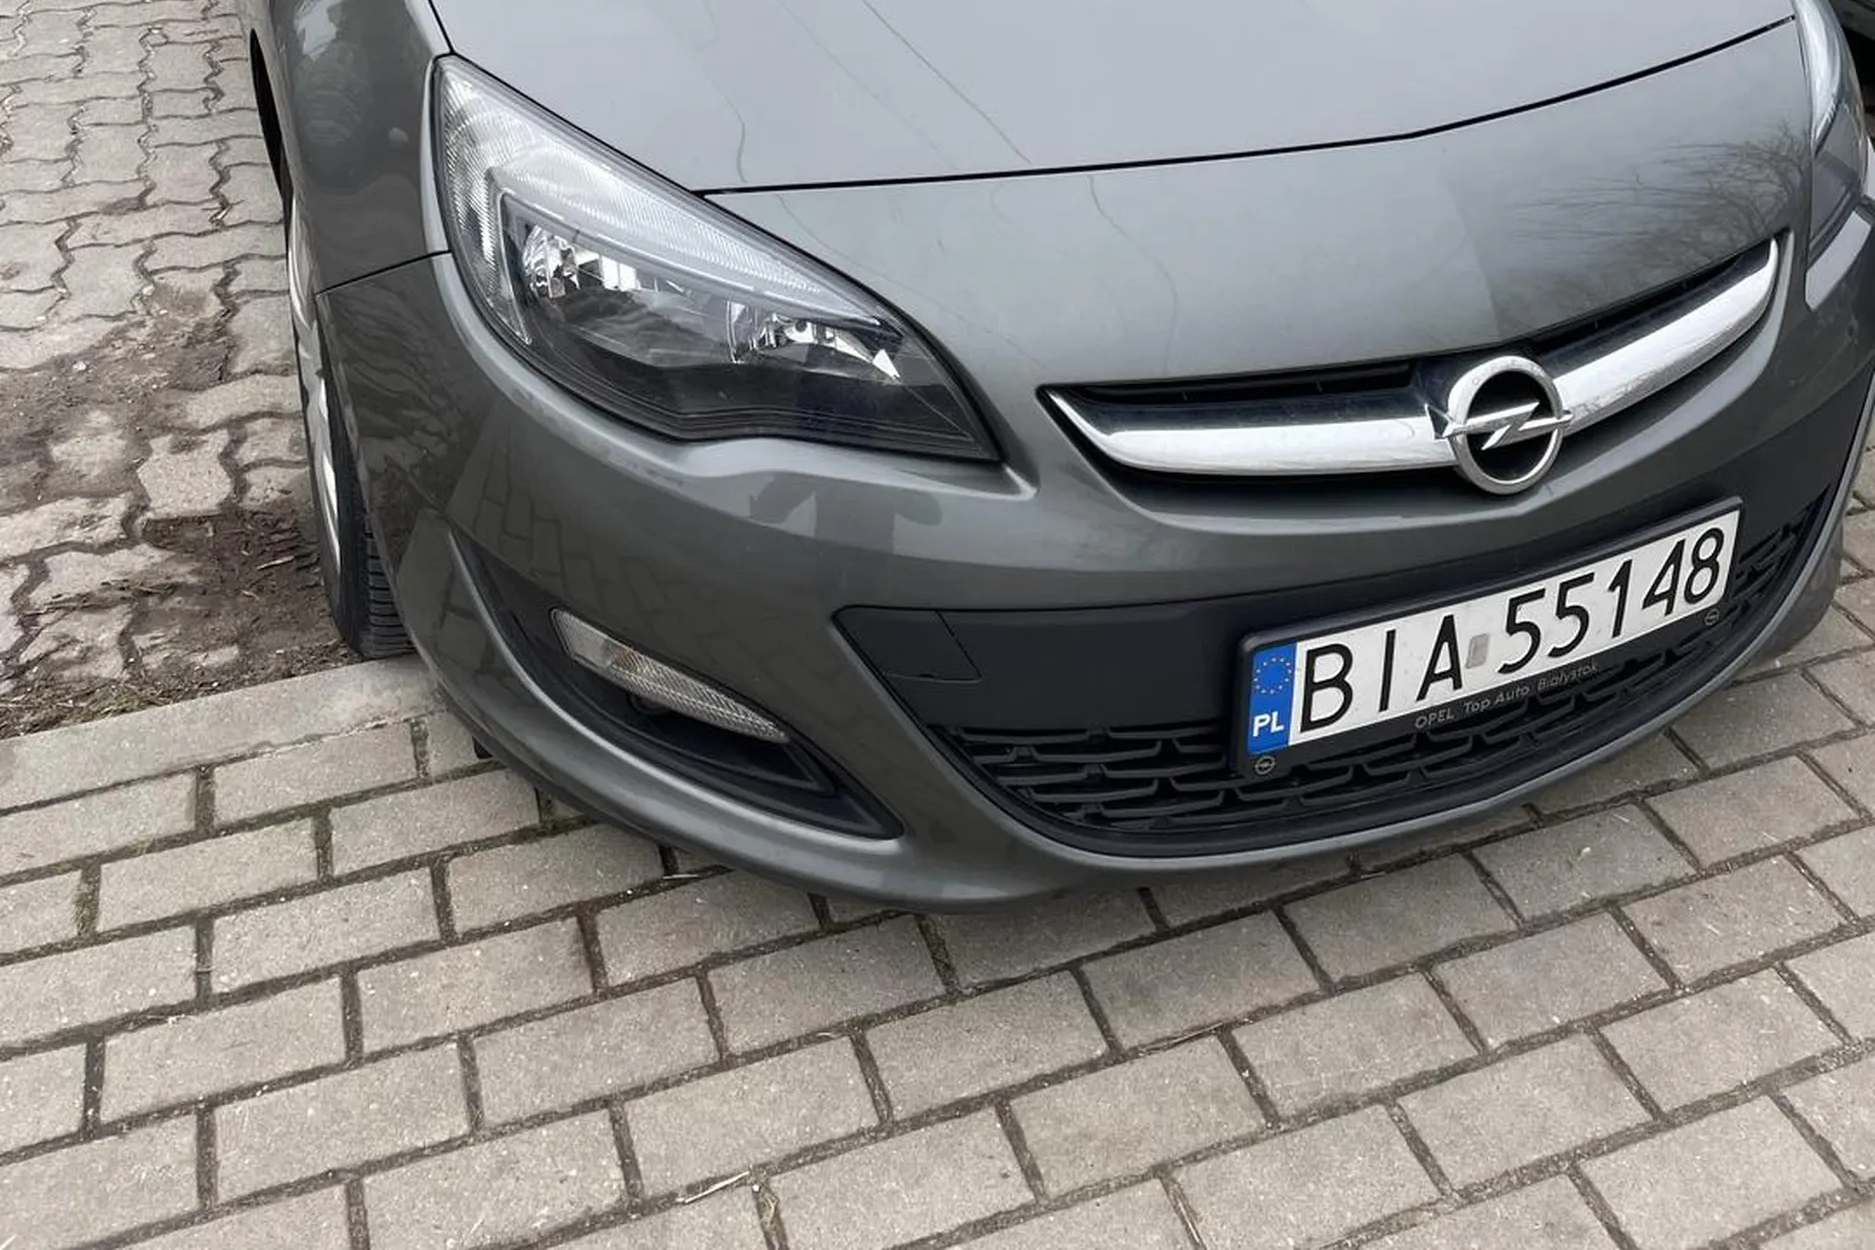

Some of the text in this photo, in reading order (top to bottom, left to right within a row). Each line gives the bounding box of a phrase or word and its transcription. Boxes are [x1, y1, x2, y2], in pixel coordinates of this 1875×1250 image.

[1300, 527, 1725, 733] BIA 55148
[1253, 711, 1285, 737] PL
[1414, 708, 1455, 729] OPEL
[1463, 699, 1491, 714] Top
[1494, 685, 1530, 704] Auto
